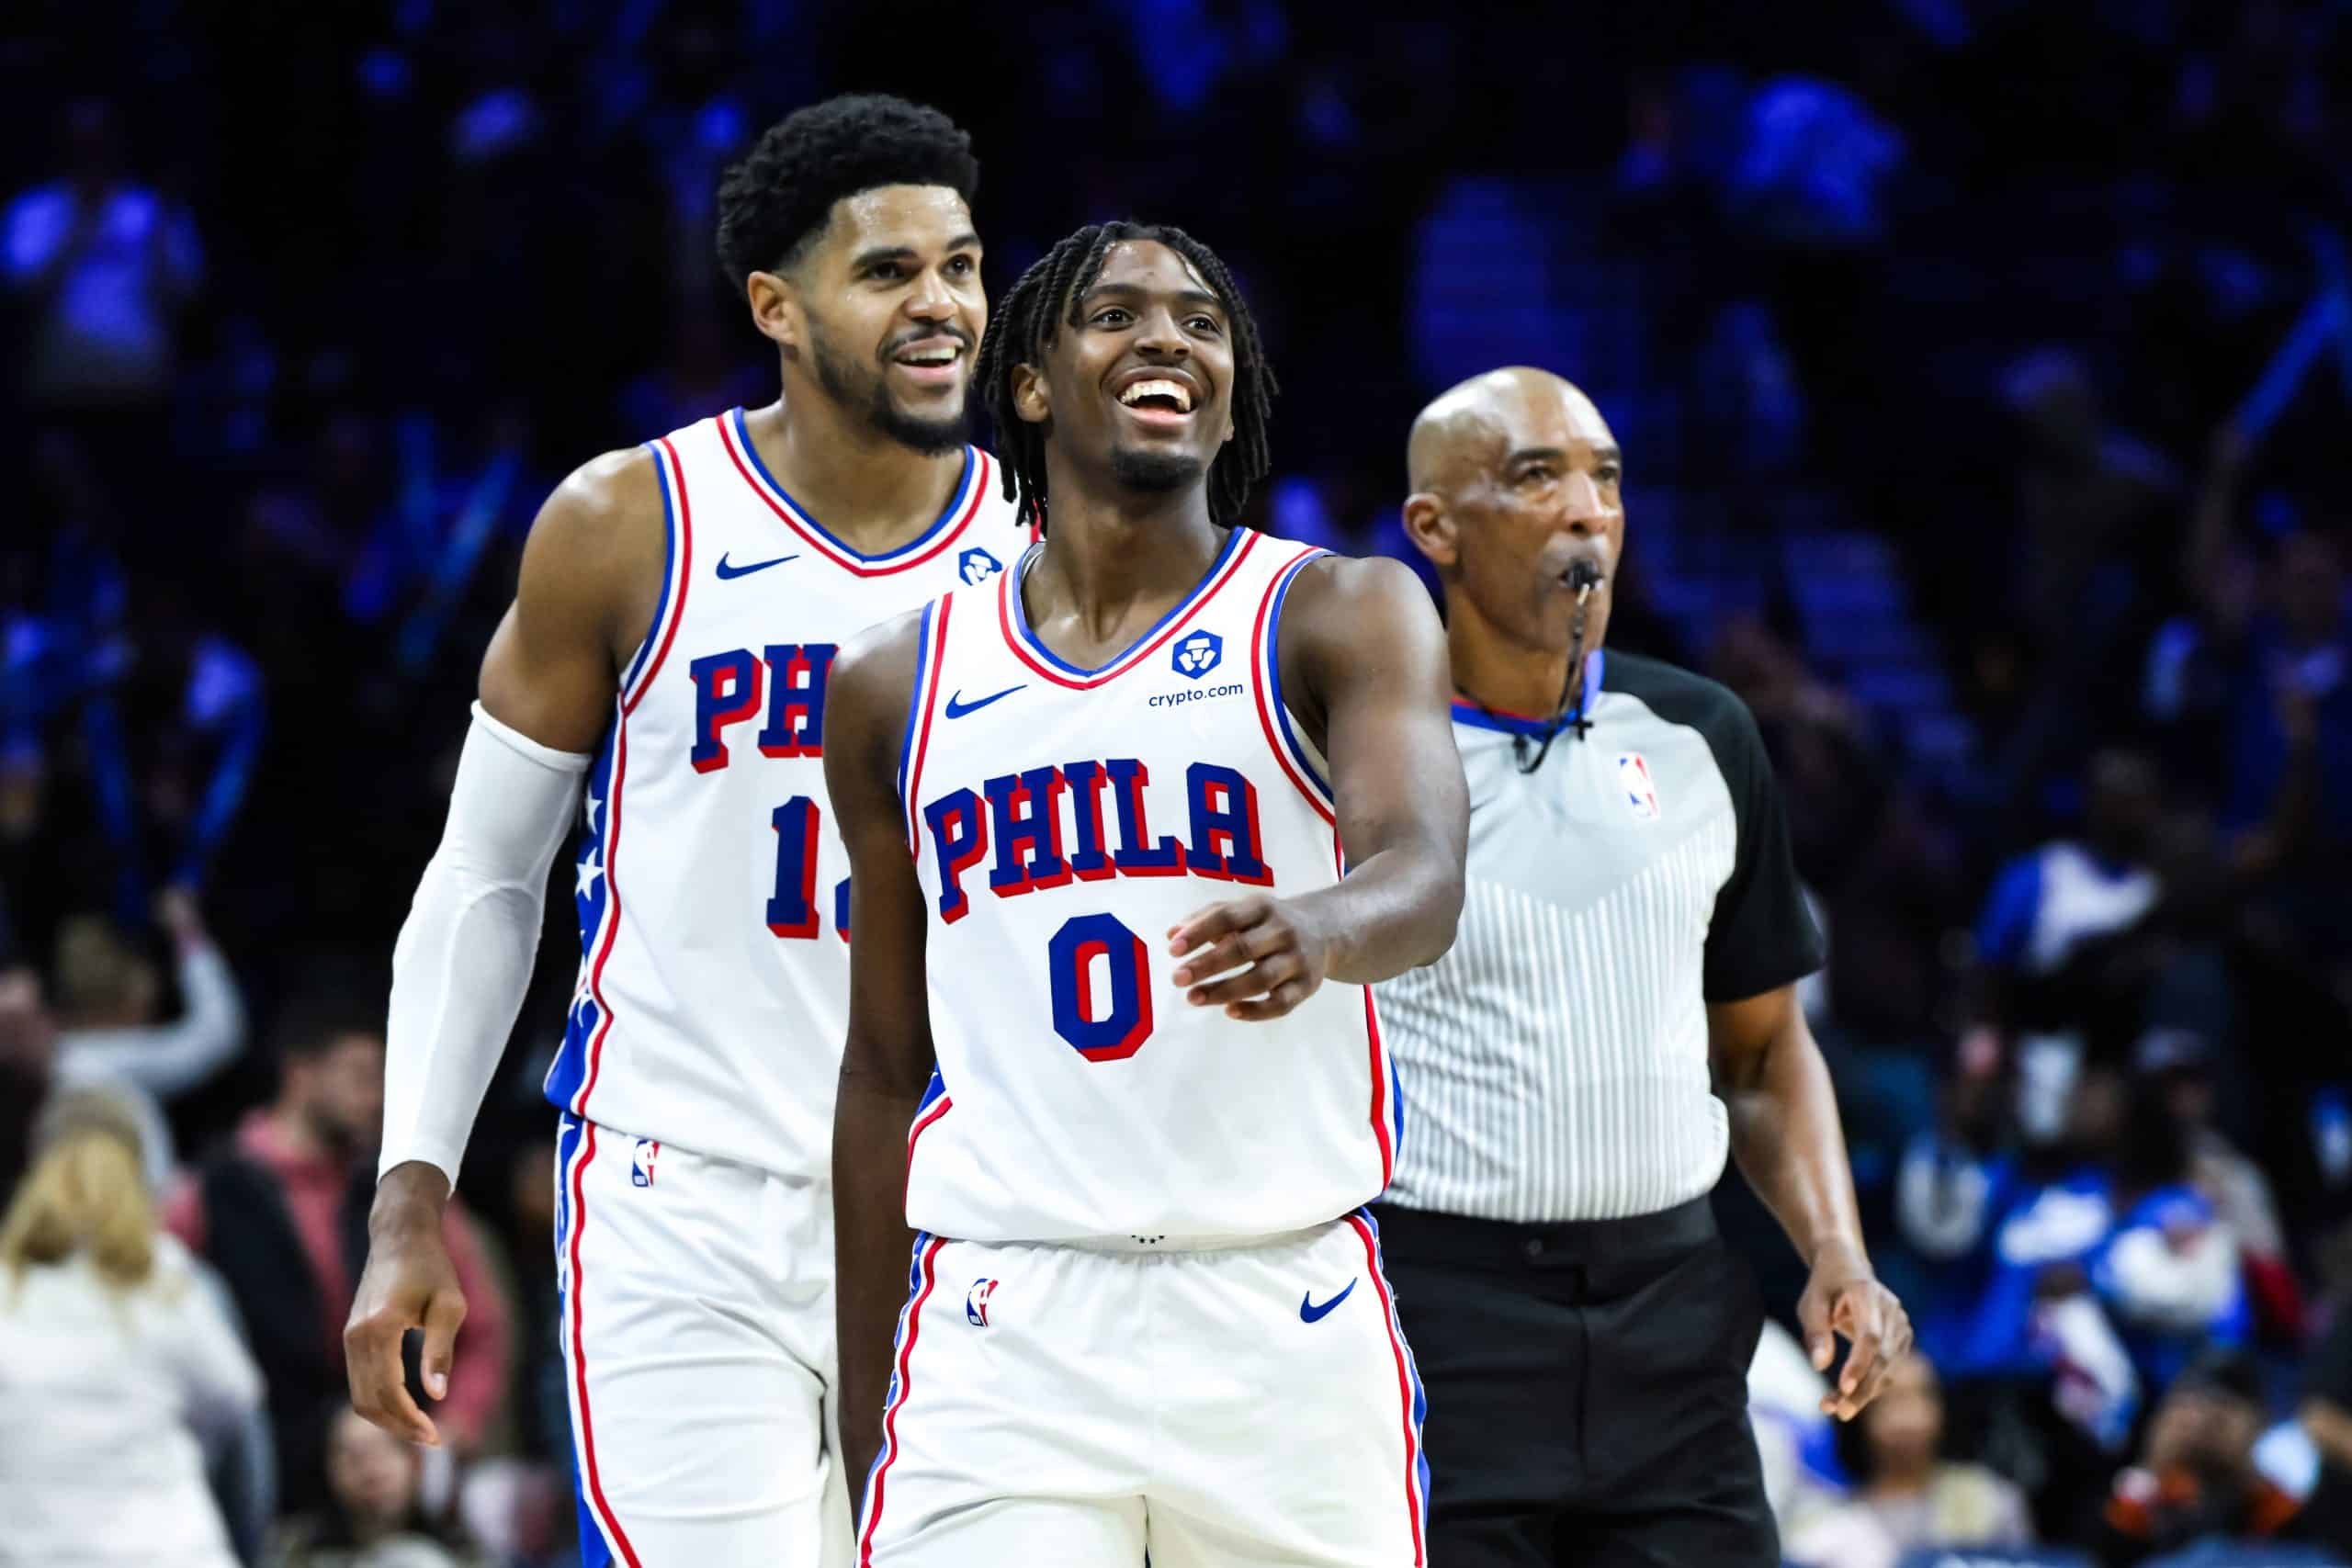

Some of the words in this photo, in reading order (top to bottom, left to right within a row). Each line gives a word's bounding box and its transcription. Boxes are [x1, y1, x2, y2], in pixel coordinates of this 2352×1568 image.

[1148, 683, 1243, 707] crypto.com
[766, 795, 851, 943] 1
[923, 759, 1274, 925] PHILA
[1048, 912, 1153, 1062] 0
